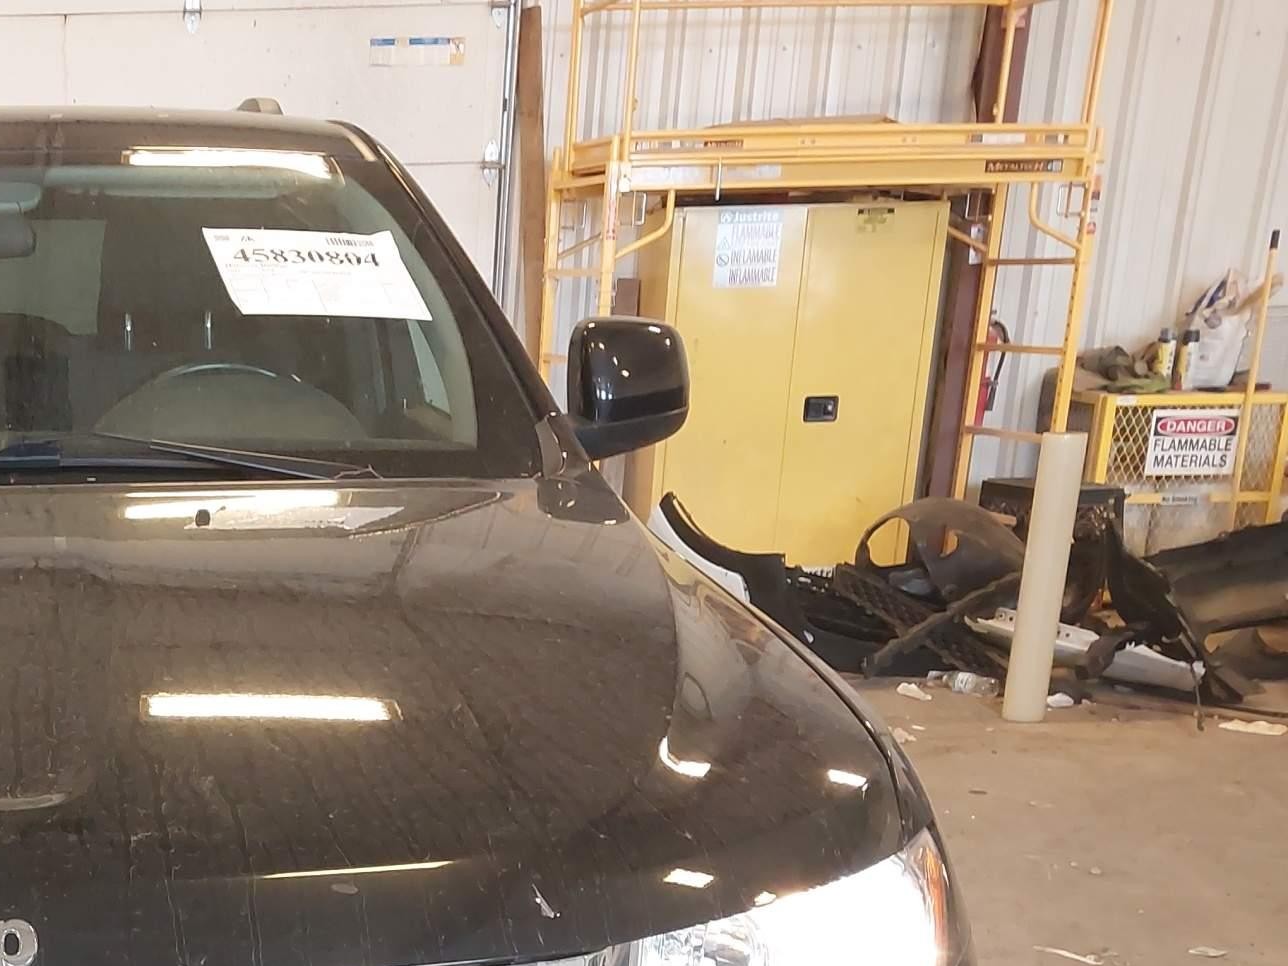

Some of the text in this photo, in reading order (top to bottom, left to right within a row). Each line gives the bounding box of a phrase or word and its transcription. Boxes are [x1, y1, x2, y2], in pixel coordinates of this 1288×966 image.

[233, 248, 380, 267] 45830804
[730, 248, 777, 265] INFLAMABLE
[728, 266, 776, 285] INFLAMMABLE
[1166, 420, 1226, 433] DANGER
[1153, 438, 1233, 452] FLAMMABLE
[1153, 454, 1227, 468] MATERIALS
